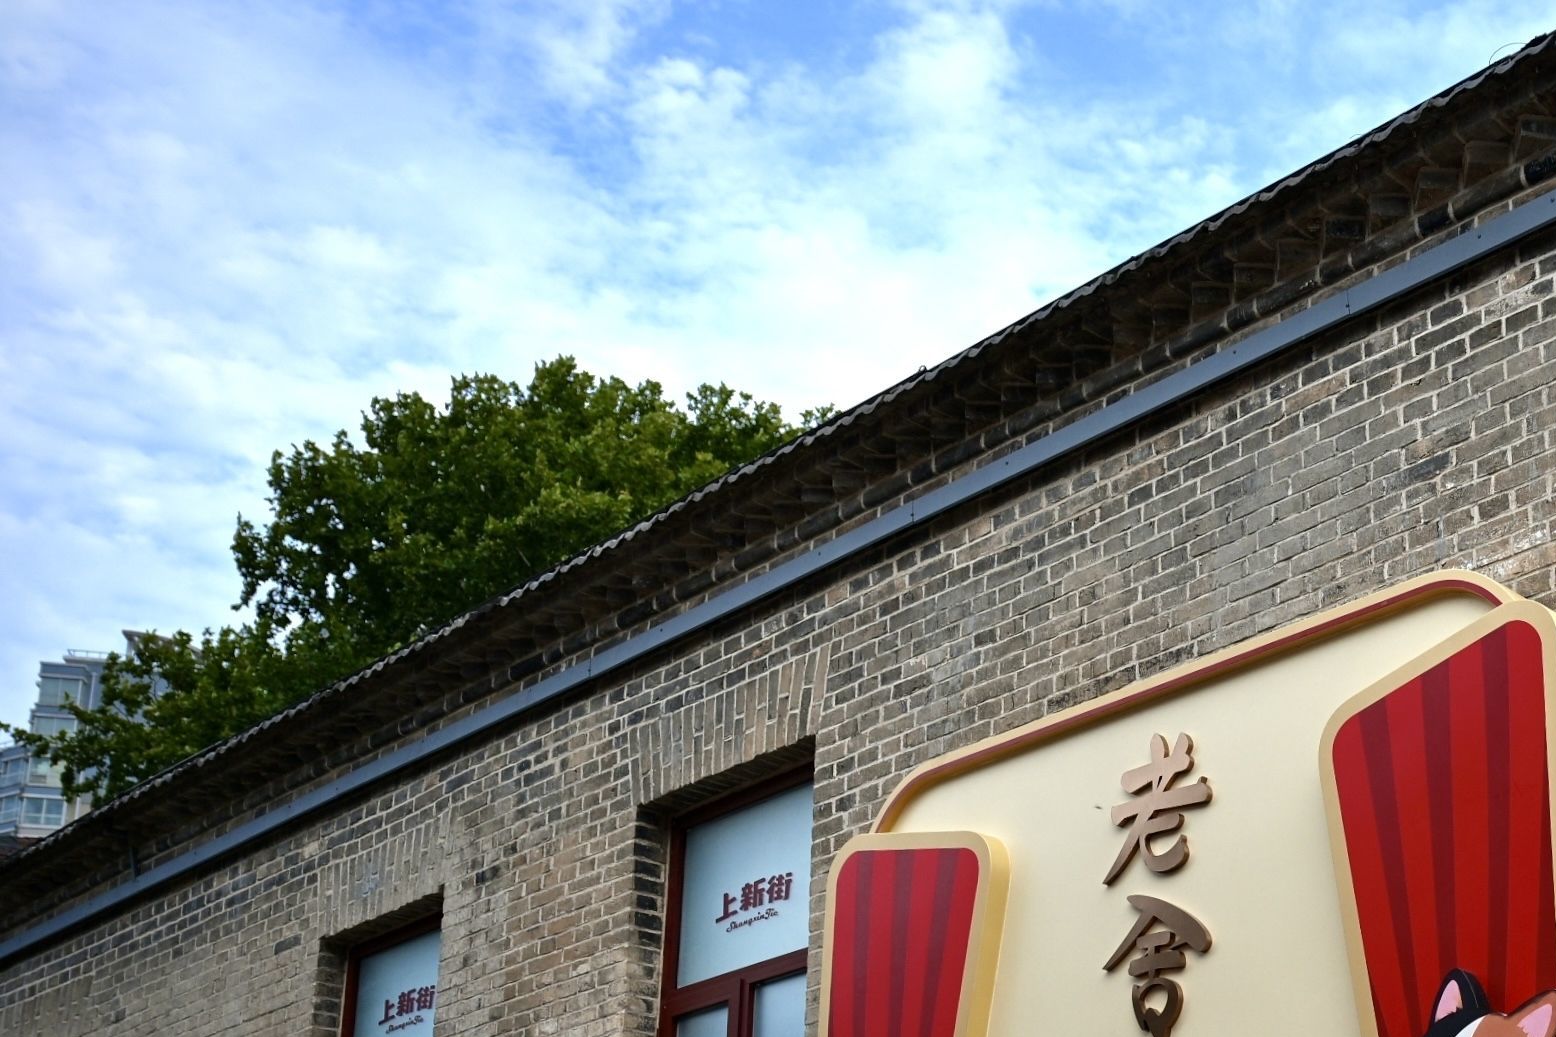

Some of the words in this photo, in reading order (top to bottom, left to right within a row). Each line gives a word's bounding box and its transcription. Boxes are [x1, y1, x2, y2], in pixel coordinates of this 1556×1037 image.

[715, 872, 793, 924] 上新街
[378, 985, 436, 1026] 上新街
